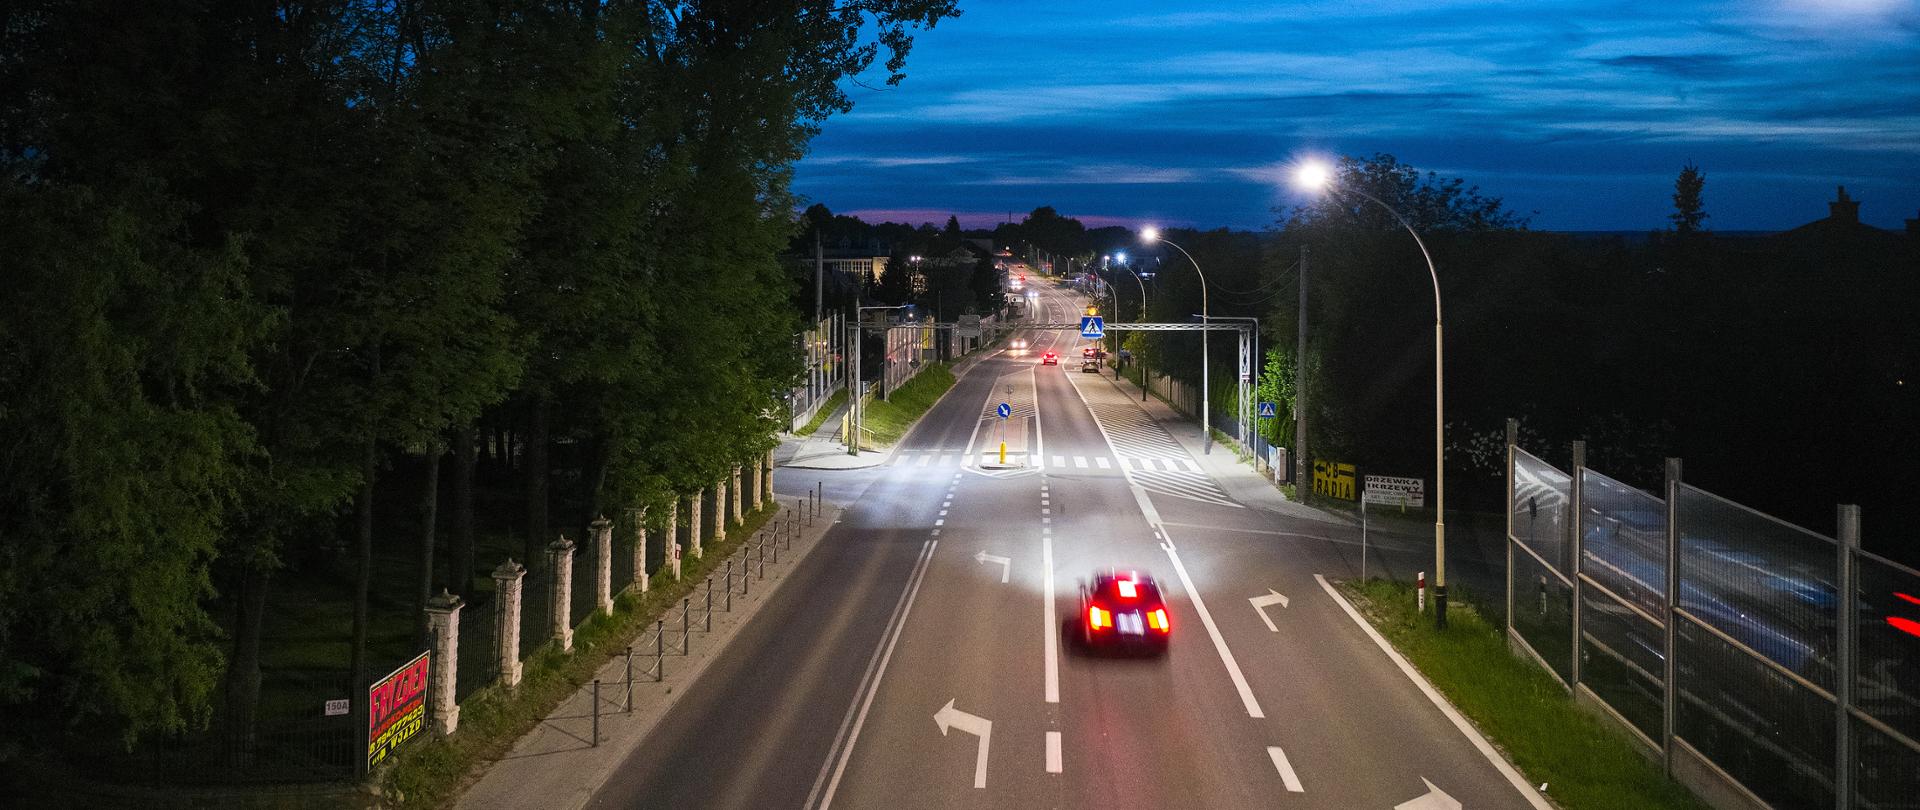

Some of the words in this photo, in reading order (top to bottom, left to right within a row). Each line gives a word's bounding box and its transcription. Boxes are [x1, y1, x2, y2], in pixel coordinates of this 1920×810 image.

[1325, 461, 1339, 479] CB
[1316, 478, 1351, 500] RADIA
[326, 701, 348, 711] 150A
[390, 719, 421, 750] WJAZD
